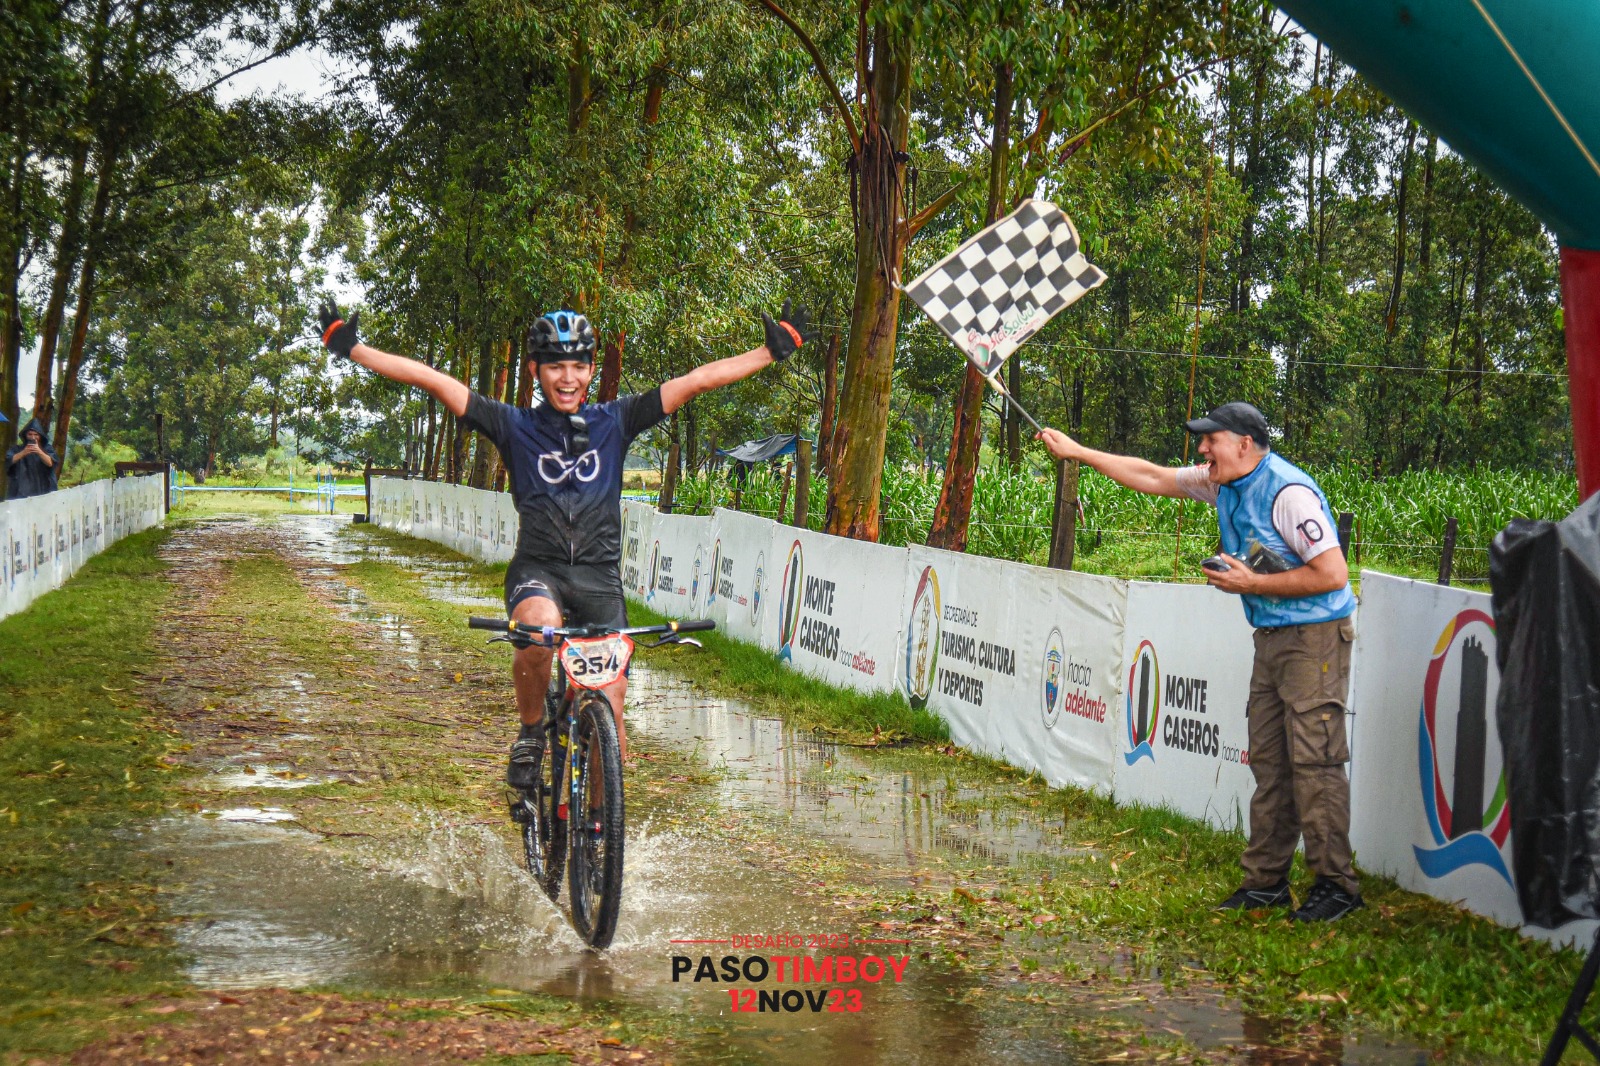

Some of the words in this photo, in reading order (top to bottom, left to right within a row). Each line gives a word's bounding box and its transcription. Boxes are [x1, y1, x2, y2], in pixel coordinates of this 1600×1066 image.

[804, 575, 836, 616] MONTE
[800, 616, 840, 661] CASEROS
[970, 611, 978, 628] DE
[573, 655, 618, 676] 354
[941, 631, 976, 670] TURISMO,
[979, 641, 1015, 676] CULTURA
[1067, 655, 1092, 687] hacia
[938, 668, 944, 692] Y
[944, 670, 984, 707] DEPORTES
[1065, 688, 1106, 723] adelante
[1165, 675, 1208, 713] MONTE
[1163, 715, 1219, 758] CASEROS
[1221, 742, 1239, 763] hacia
